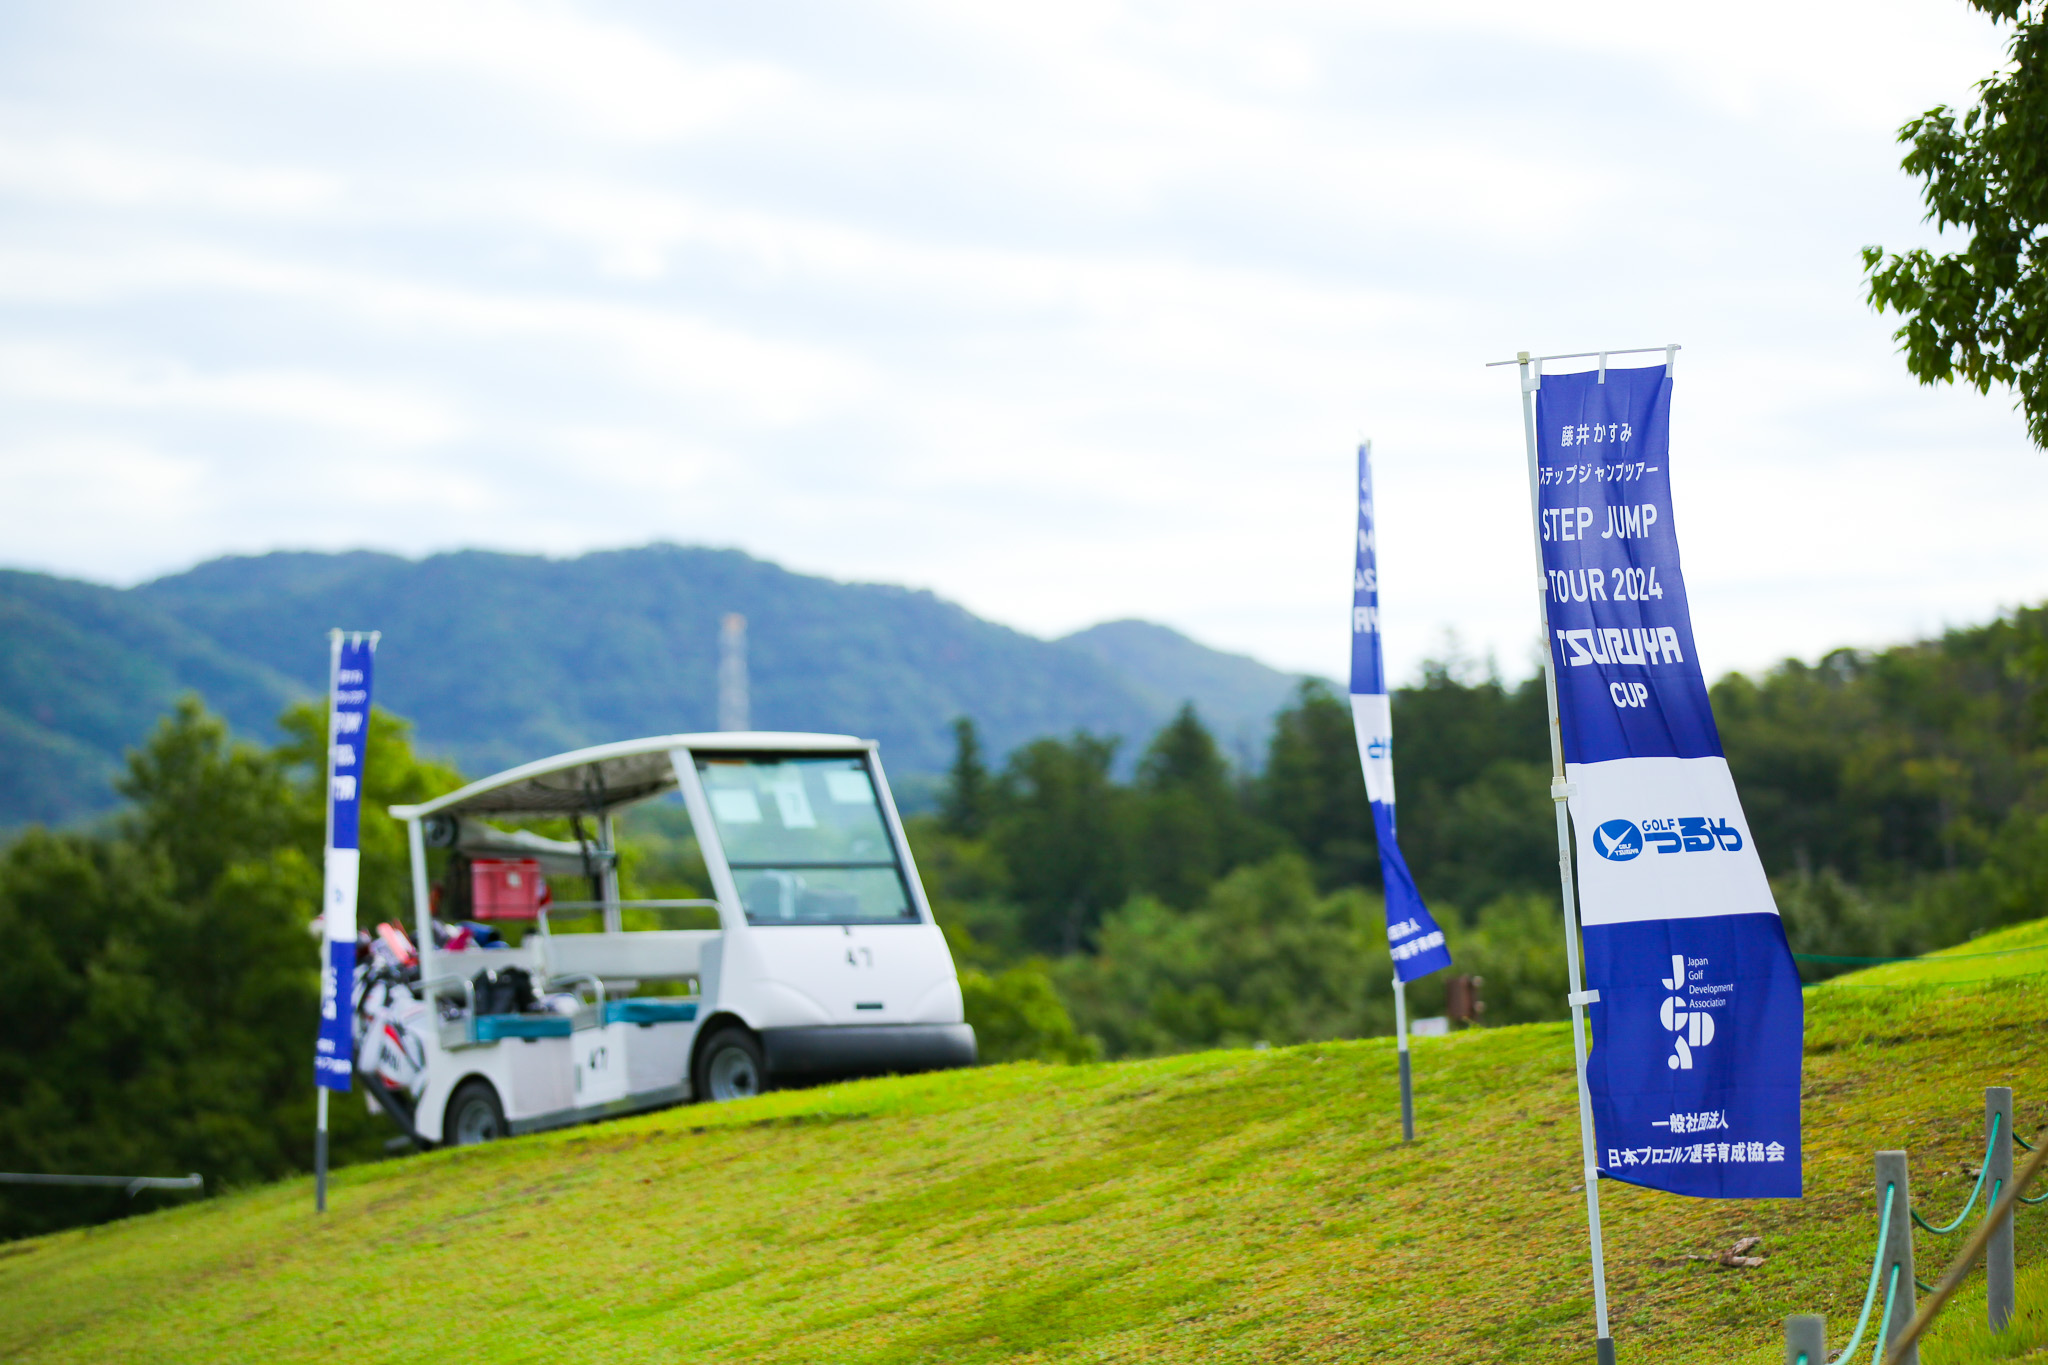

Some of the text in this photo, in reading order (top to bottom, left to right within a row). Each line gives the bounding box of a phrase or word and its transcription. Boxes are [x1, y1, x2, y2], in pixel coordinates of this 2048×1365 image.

[1561, 422, 1632, 448] 藤井かすみ
[1543, 503, 1658, 542] STEP JUMP
[1549, 566, 1664, 604] TOUR 2024
[1556, 626, 1684, 667] TSURUYA
[1609, 682, 1649, 708] CUP
[1642, 818, 1676, 832] GOLF
[1687, 957, 1709, 968] Japan
[1688, 969, 1704, 981] Golf
[1689, 983, 1734, 995] Development
[1689, 998, 1726, 1009] Association
[1651, 1109, 1729, 1134] 一般社団法人
[1607, 1140, 1785, 1169] 日本プロゴルフ選手育成協会
